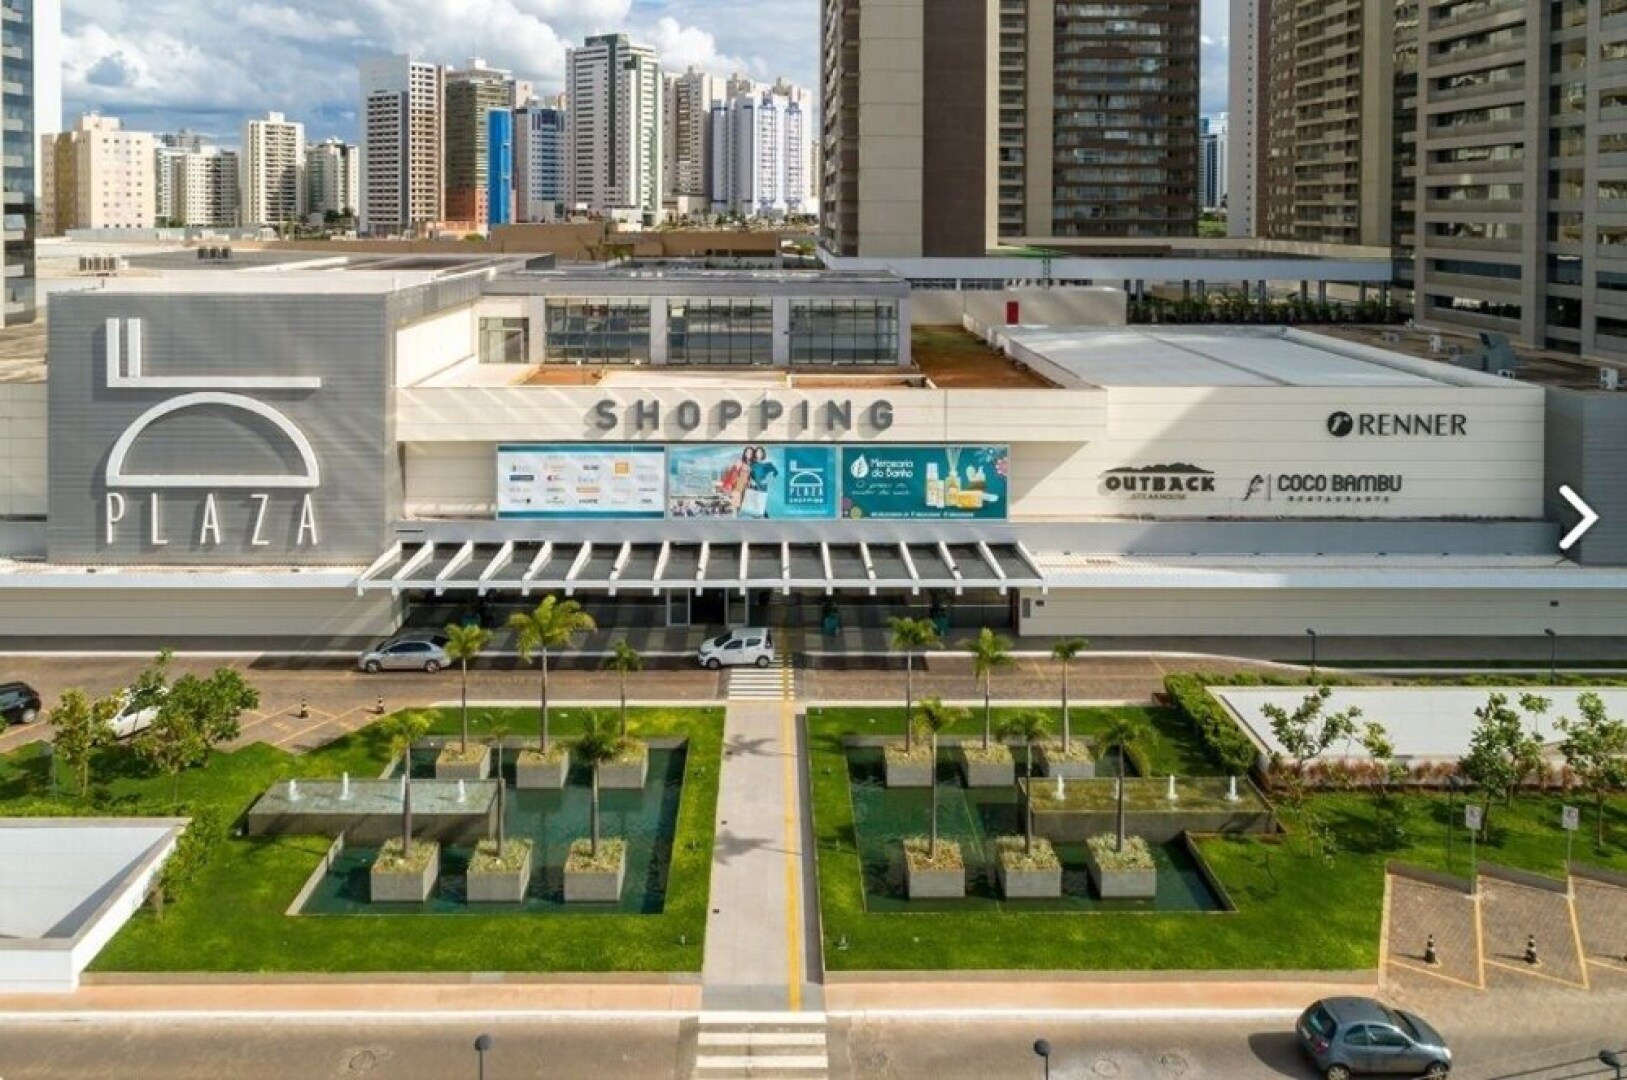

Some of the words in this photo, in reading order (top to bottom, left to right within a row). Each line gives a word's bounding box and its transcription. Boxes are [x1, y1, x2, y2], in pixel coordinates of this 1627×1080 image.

[595, 399, 894, 431] SHOPPING
[1358, 413, 1467, 436] RENNER
[790, 487, 824, 496] PLAZA
[1105, 476, 1215, 492] OUTBACK
[1278, 475, 1326, 492] COCO
[1332, 475, 1402, 492] BAMBU
[106, 492, 319, 546] PLAZA
